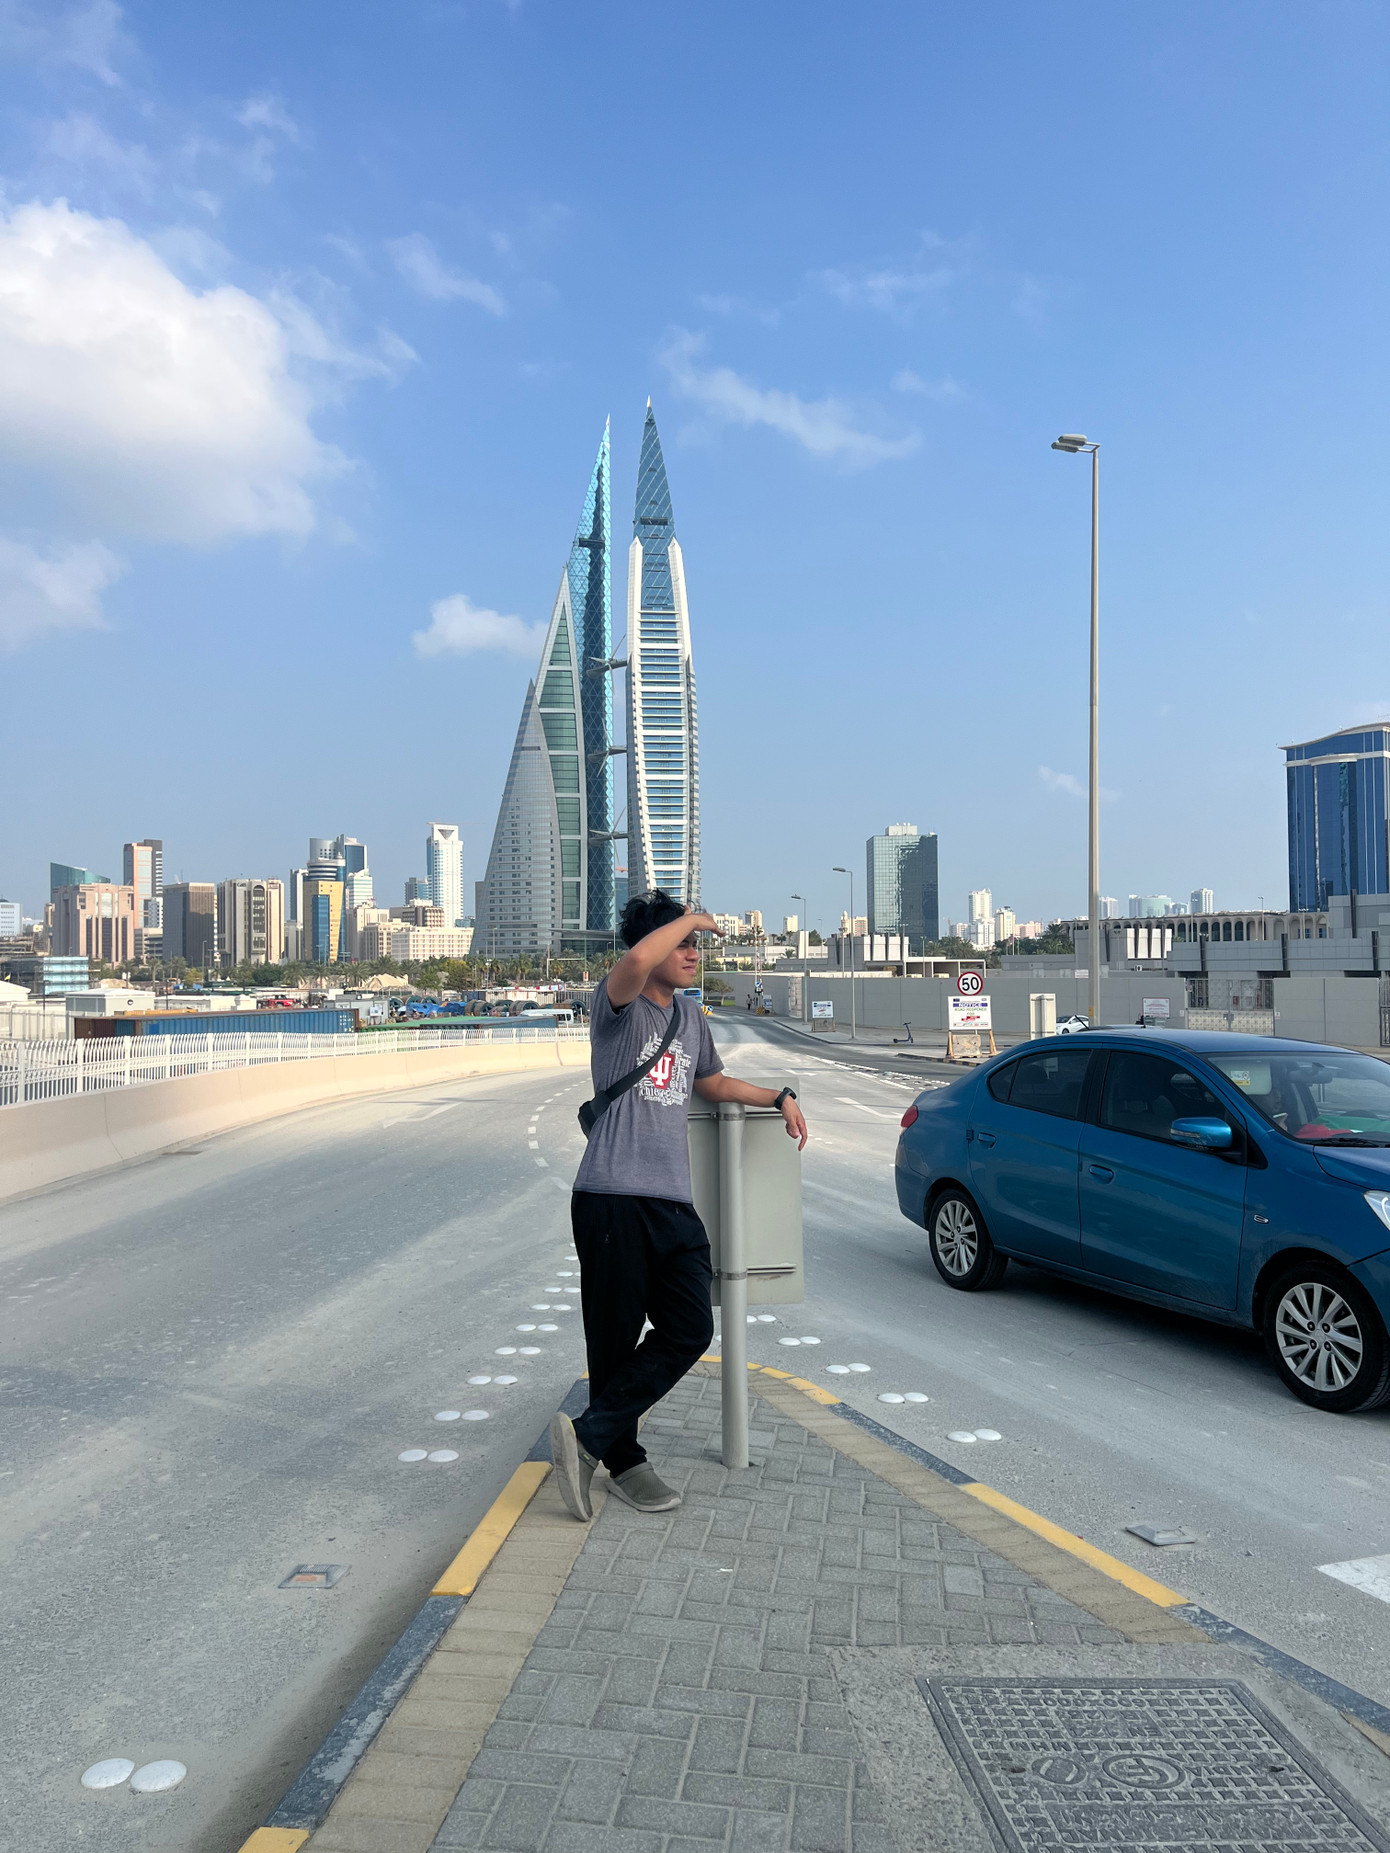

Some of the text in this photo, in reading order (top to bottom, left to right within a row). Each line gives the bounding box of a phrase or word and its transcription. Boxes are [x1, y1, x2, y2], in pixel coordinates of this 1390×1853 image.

[962, 977, 979, 991] 50
[1126, 1727, 1164, 1737] EN
[1009, 1741, 1073, 1751] MHM
[1182, 1765, 1260, 1776] INDIA
